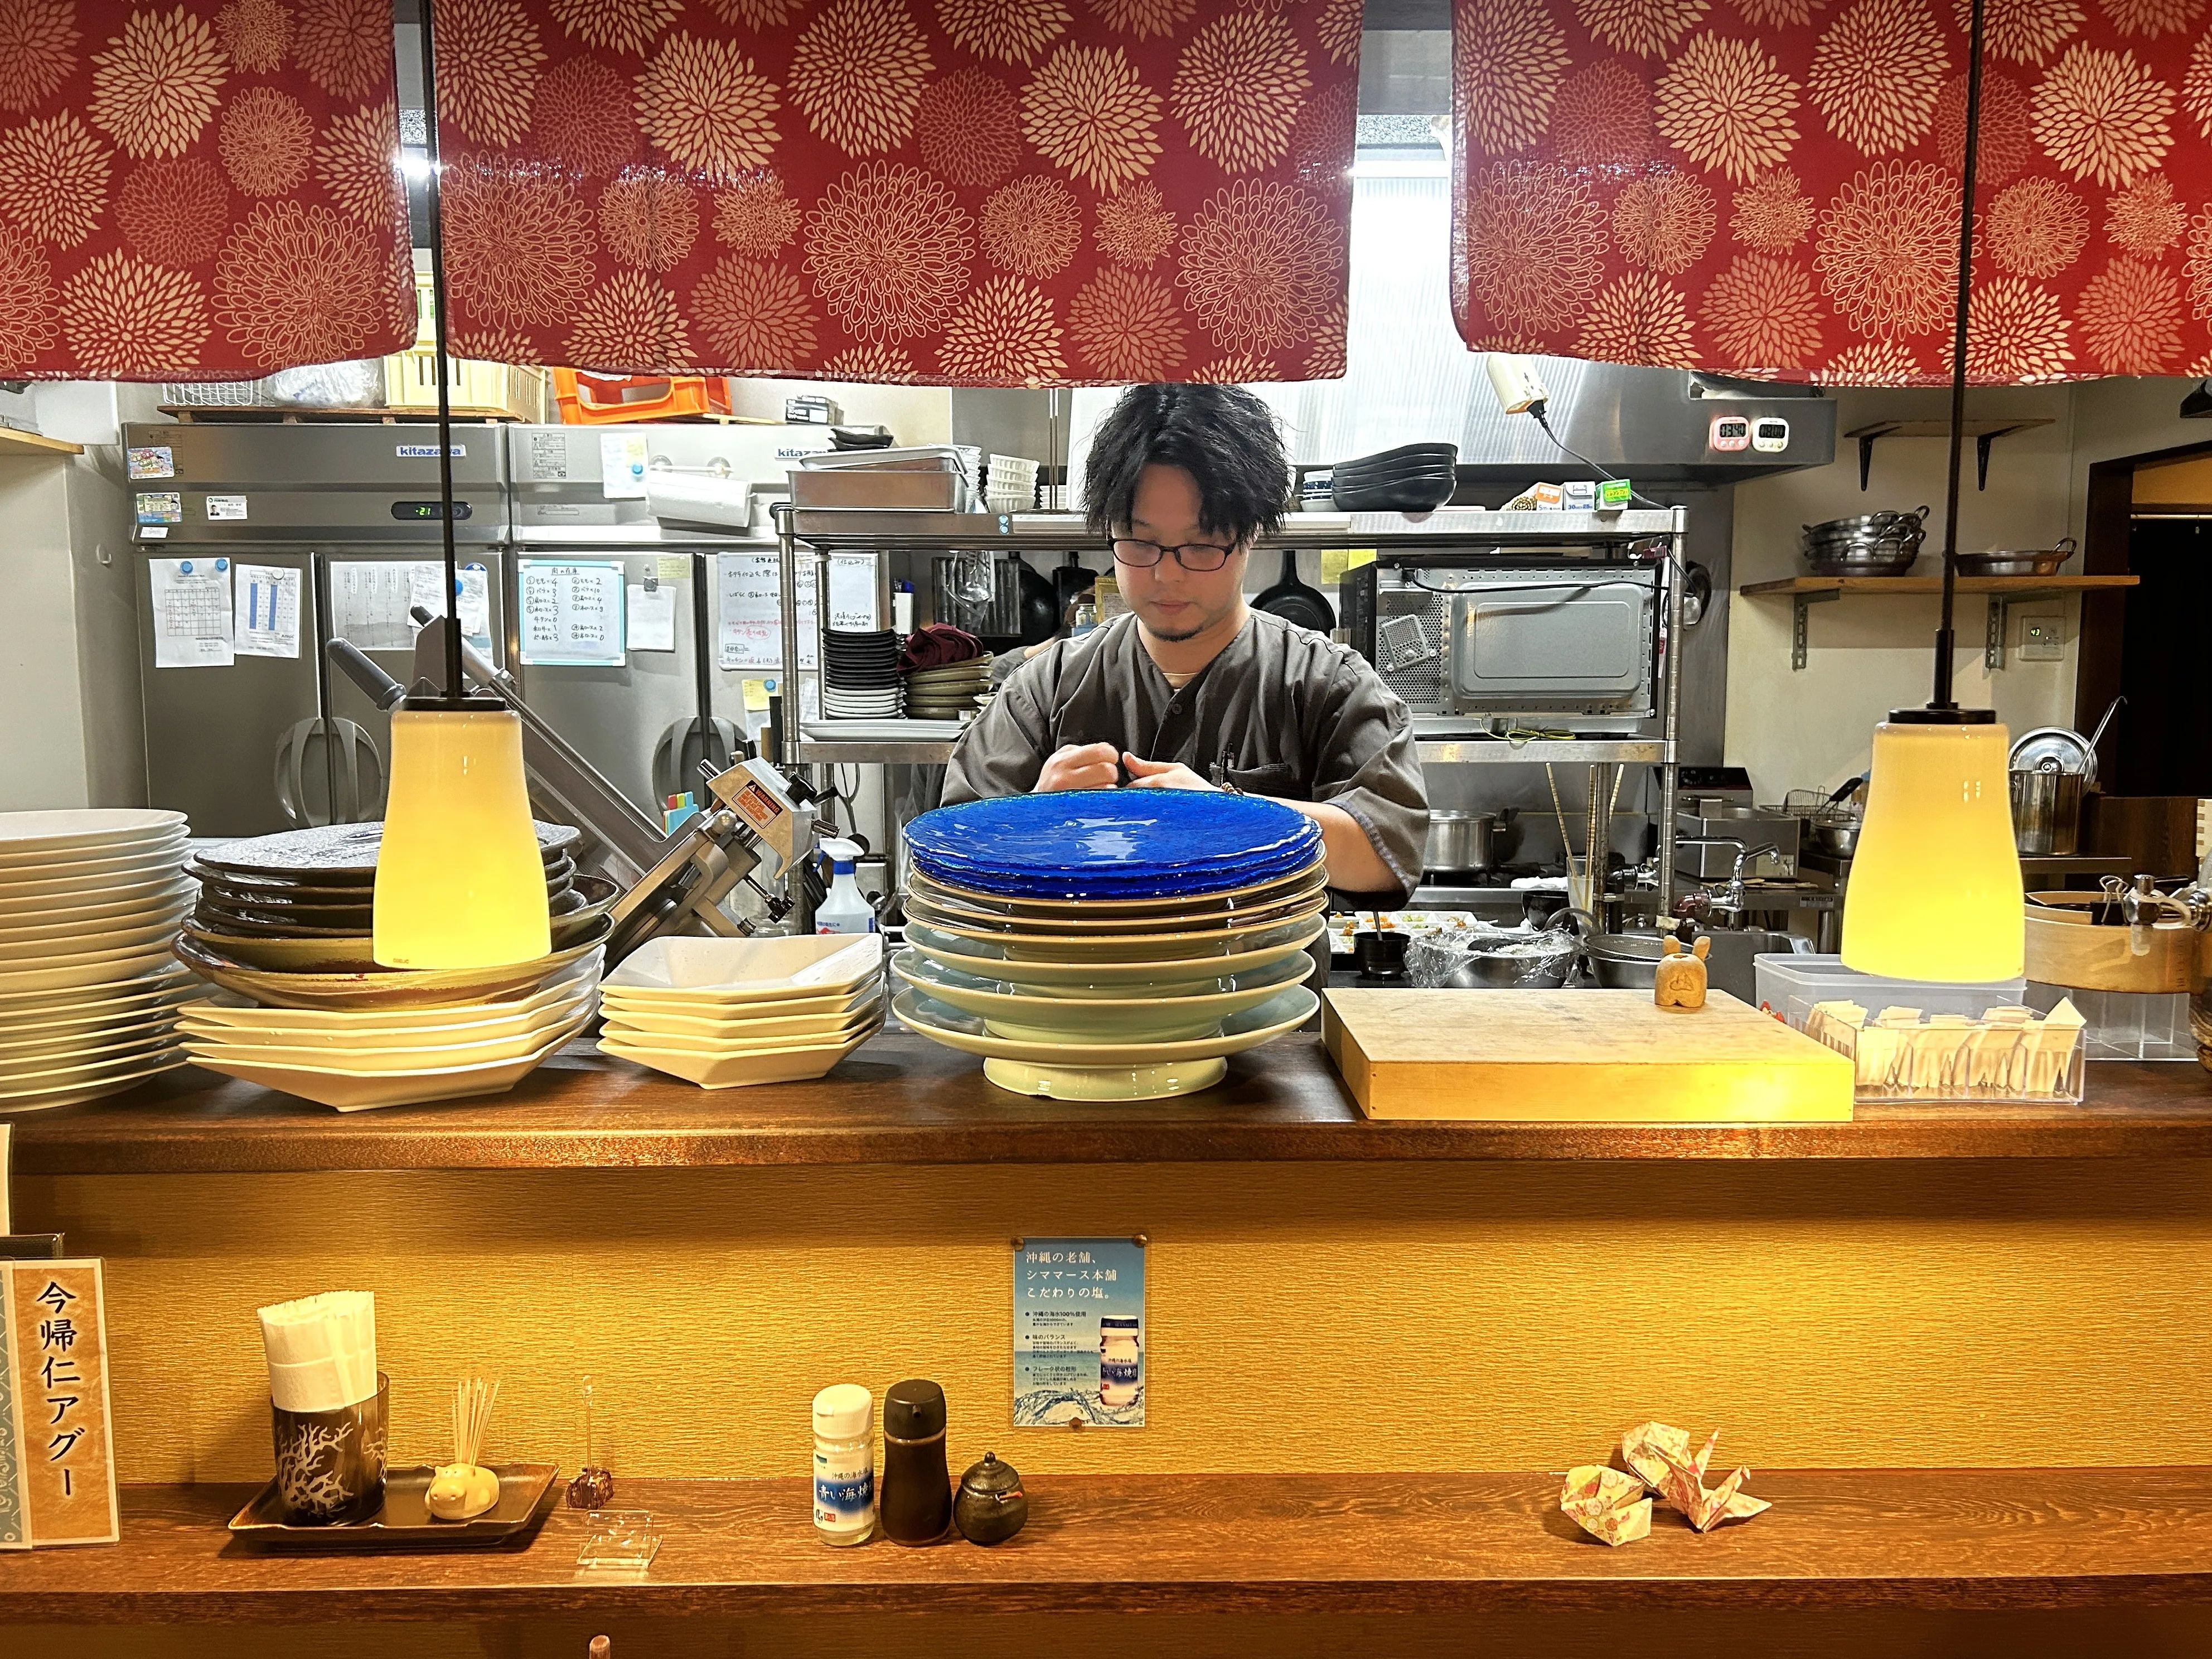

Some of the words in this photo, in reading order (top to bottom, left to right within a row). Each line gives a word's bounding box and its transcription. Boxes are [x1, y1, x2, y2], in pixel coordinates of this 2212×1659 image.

[400, 447, 461, 456] kitazaa
[755, 789, 780, 814] WARNING
[1027, 1251, 1096, 1264] 沖縄の老舗、
[1027, 1269, 1116, 1281] シママース本舗
[1028, 1286, 1109, 1299] こだわりの塩。
[36, 1281, 85, 1496] 今帰仁アグー
